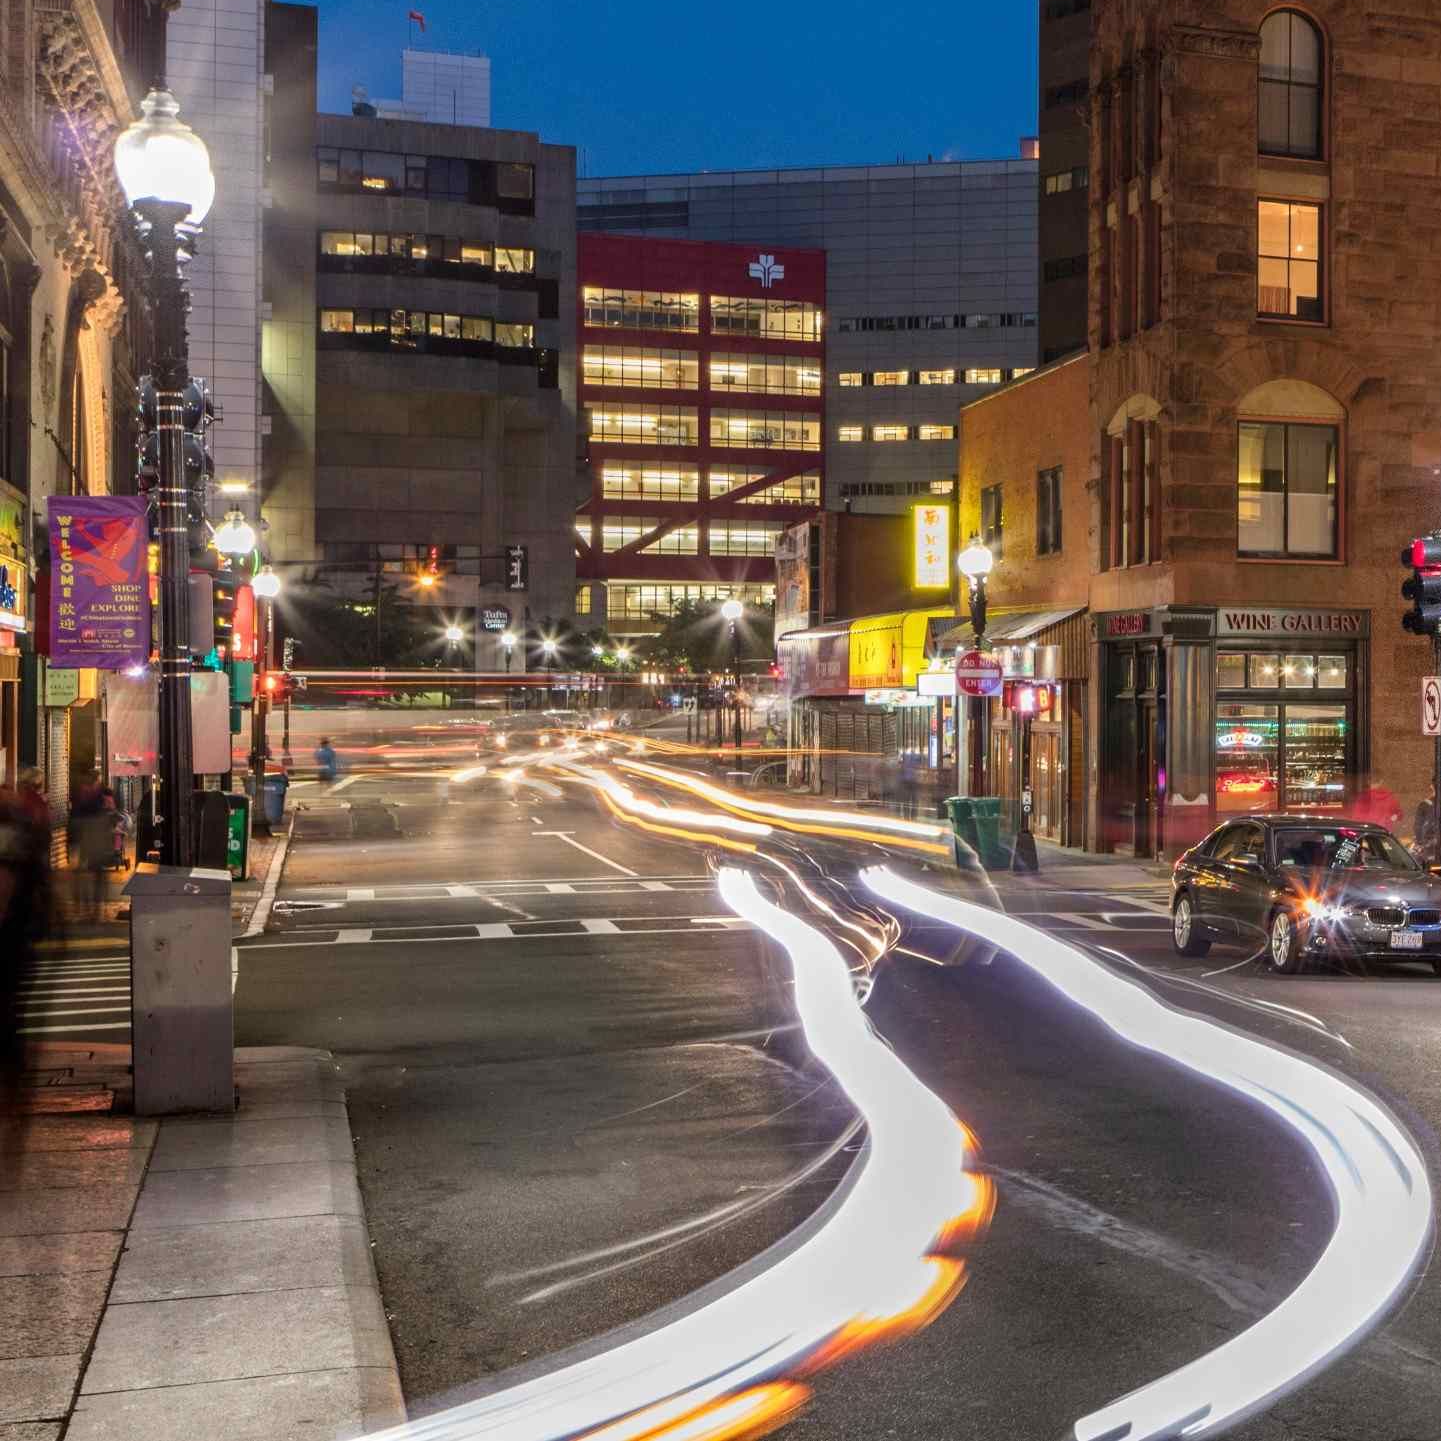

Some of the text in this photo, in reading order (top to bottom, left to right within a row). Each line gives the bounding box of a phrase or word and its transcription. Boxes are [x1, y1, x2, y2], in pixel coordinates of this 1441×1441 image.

[57, 515, 74, 598] WELCOME
[1226, 614, 1361, 632] WINE GALLERY
